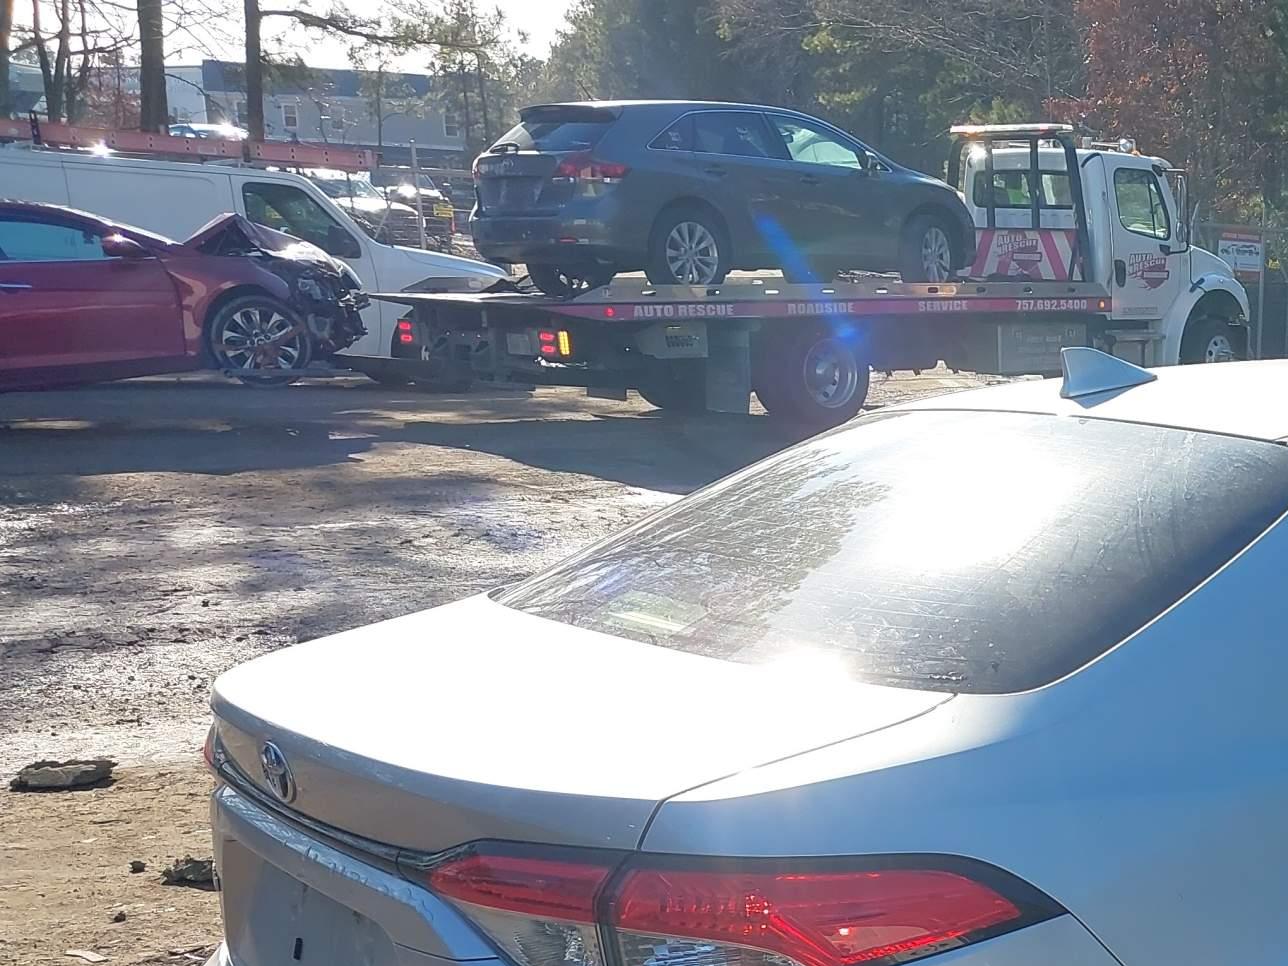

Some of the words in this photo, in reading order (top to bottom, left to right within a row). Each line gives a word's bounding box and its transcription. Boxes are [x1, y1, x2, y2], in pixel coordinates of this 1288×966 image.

[998, 232, 1023, 246] AUTO
[1130, 253, 1154, 265] AUTO
[633, 304, 674, 318] AUTO
[678, 303, 735, 317] RESCUE
[787, 302, 854, 315] ROADSIDE
[918, 300, 969, 312] SERVICE
